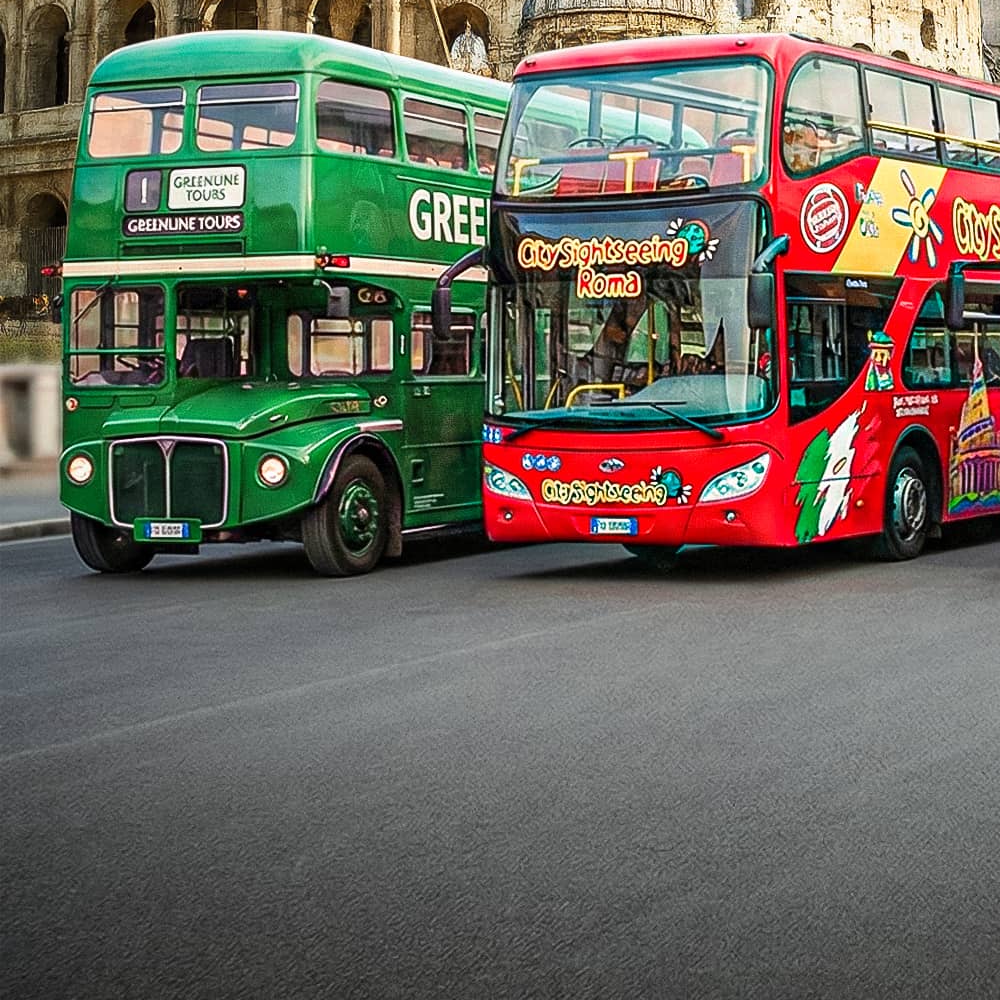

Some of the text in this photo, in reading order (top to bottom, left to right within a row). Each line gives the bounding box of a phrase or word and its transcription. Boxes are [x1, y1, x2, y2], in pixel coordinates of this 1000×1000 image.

[186, 188, 226, 201] TOURS
[198, 215, 241, 230] TOURS
[409, 188, 490, 246] GREE
[576, 266, 641, 299] Roma
